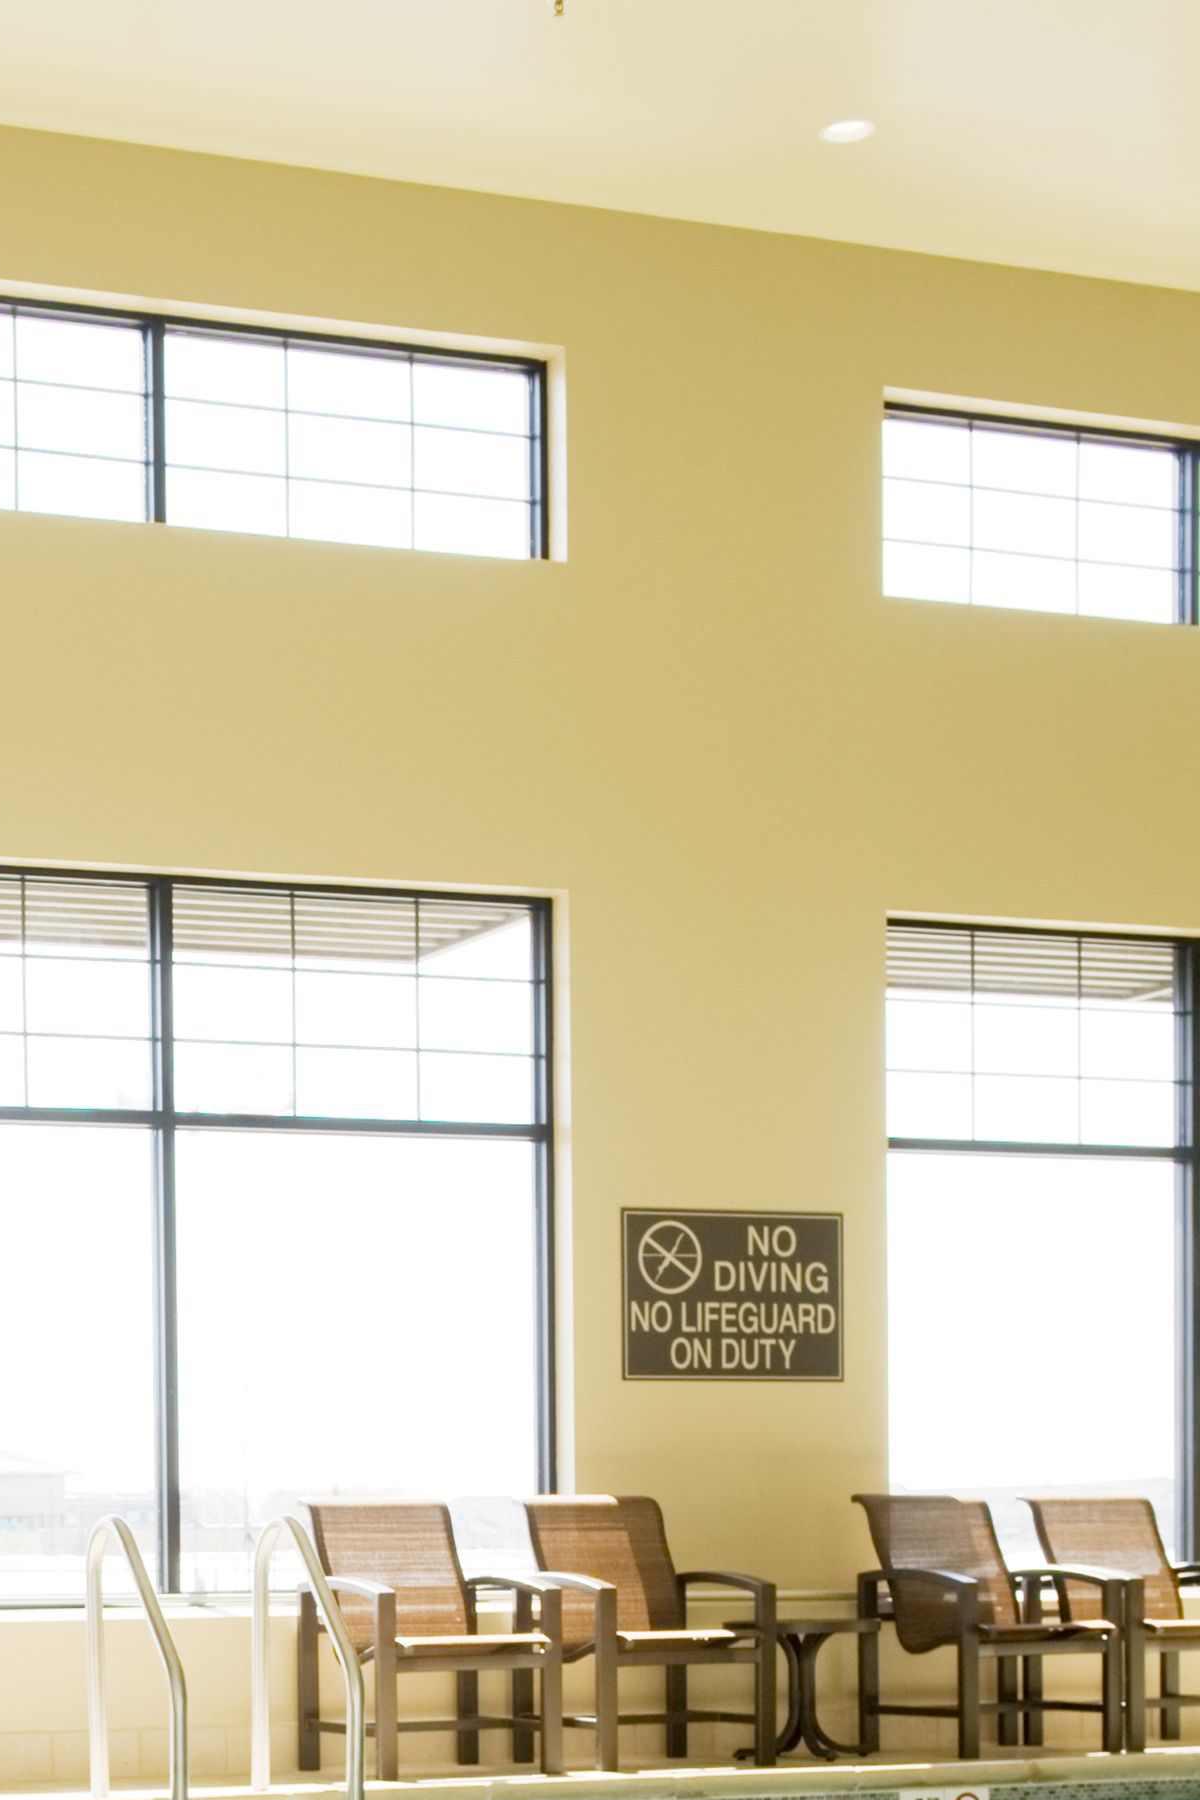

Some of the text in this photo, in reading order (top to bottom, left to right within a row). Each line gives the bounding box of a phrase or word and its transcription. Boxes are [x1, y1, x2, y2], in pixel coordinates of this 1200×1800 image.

[747, 1225, 797, 1257] NO
[714, 1261, 829, 1294] DIVING
[631, 1301, 836, 1334] NO LIFEGUARD
[670, 1337, 796, 1370] ON DUTY
